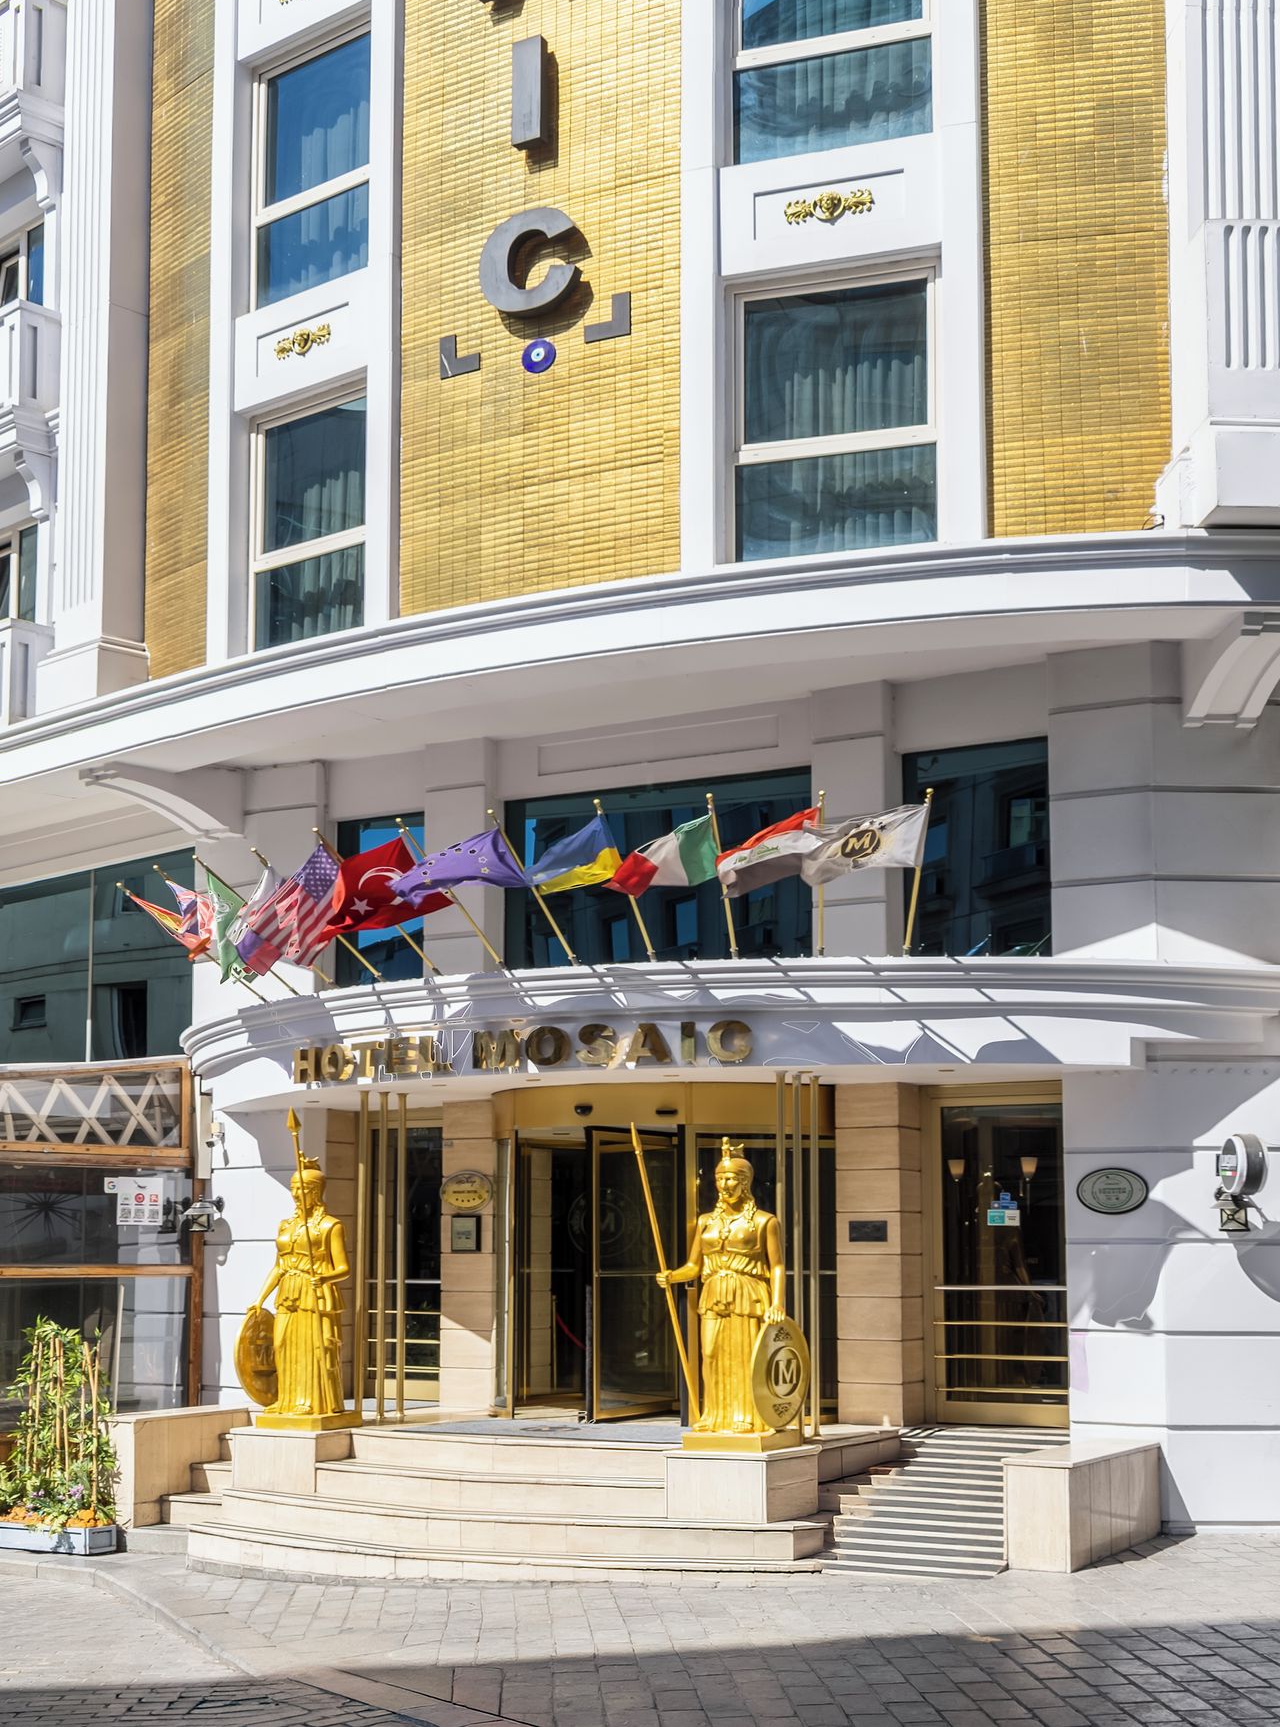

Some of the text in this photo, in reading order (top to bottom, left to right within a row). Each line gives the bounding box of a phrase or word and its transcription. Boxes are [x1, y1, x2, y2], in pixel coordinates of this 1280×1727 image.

[293, 1020, 754, 1084] HOTEL MOSAIC
[773, 1358, 797, 1386] M
